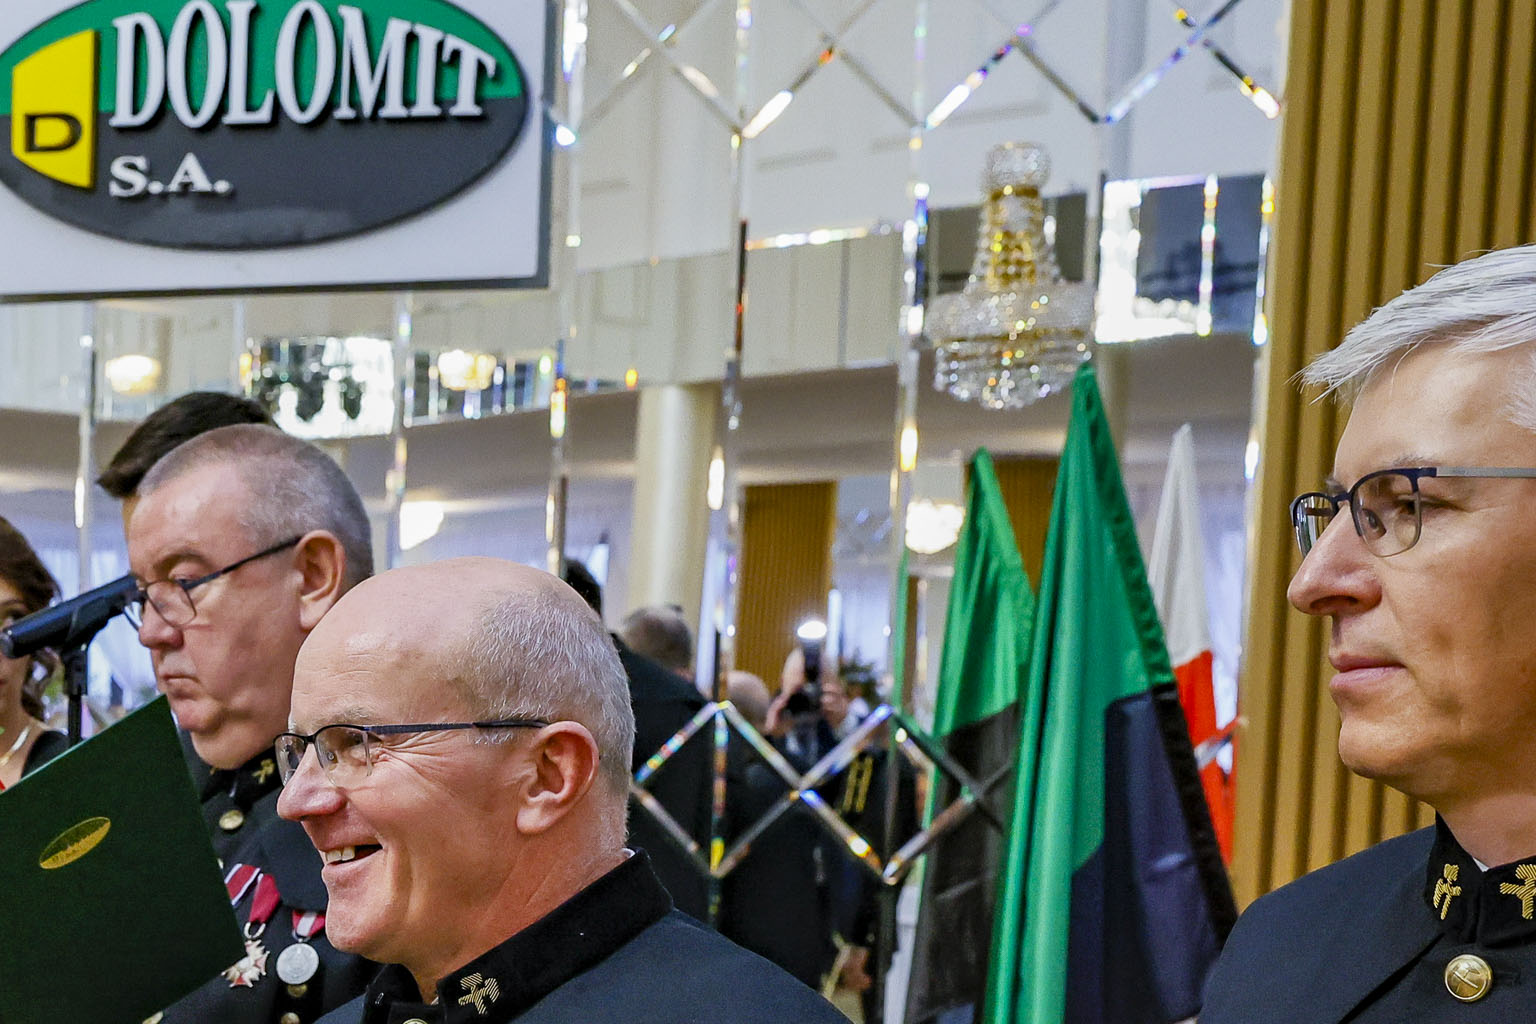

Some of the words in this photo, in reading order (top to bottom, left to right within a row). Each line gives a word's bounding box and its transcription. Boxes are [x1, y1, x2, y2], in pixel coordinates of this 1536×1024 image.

[109, 0, 496, 128] DOLOMIT
[24, 113, 81, 152] D
[109, 152, 231, 198] S.A.
